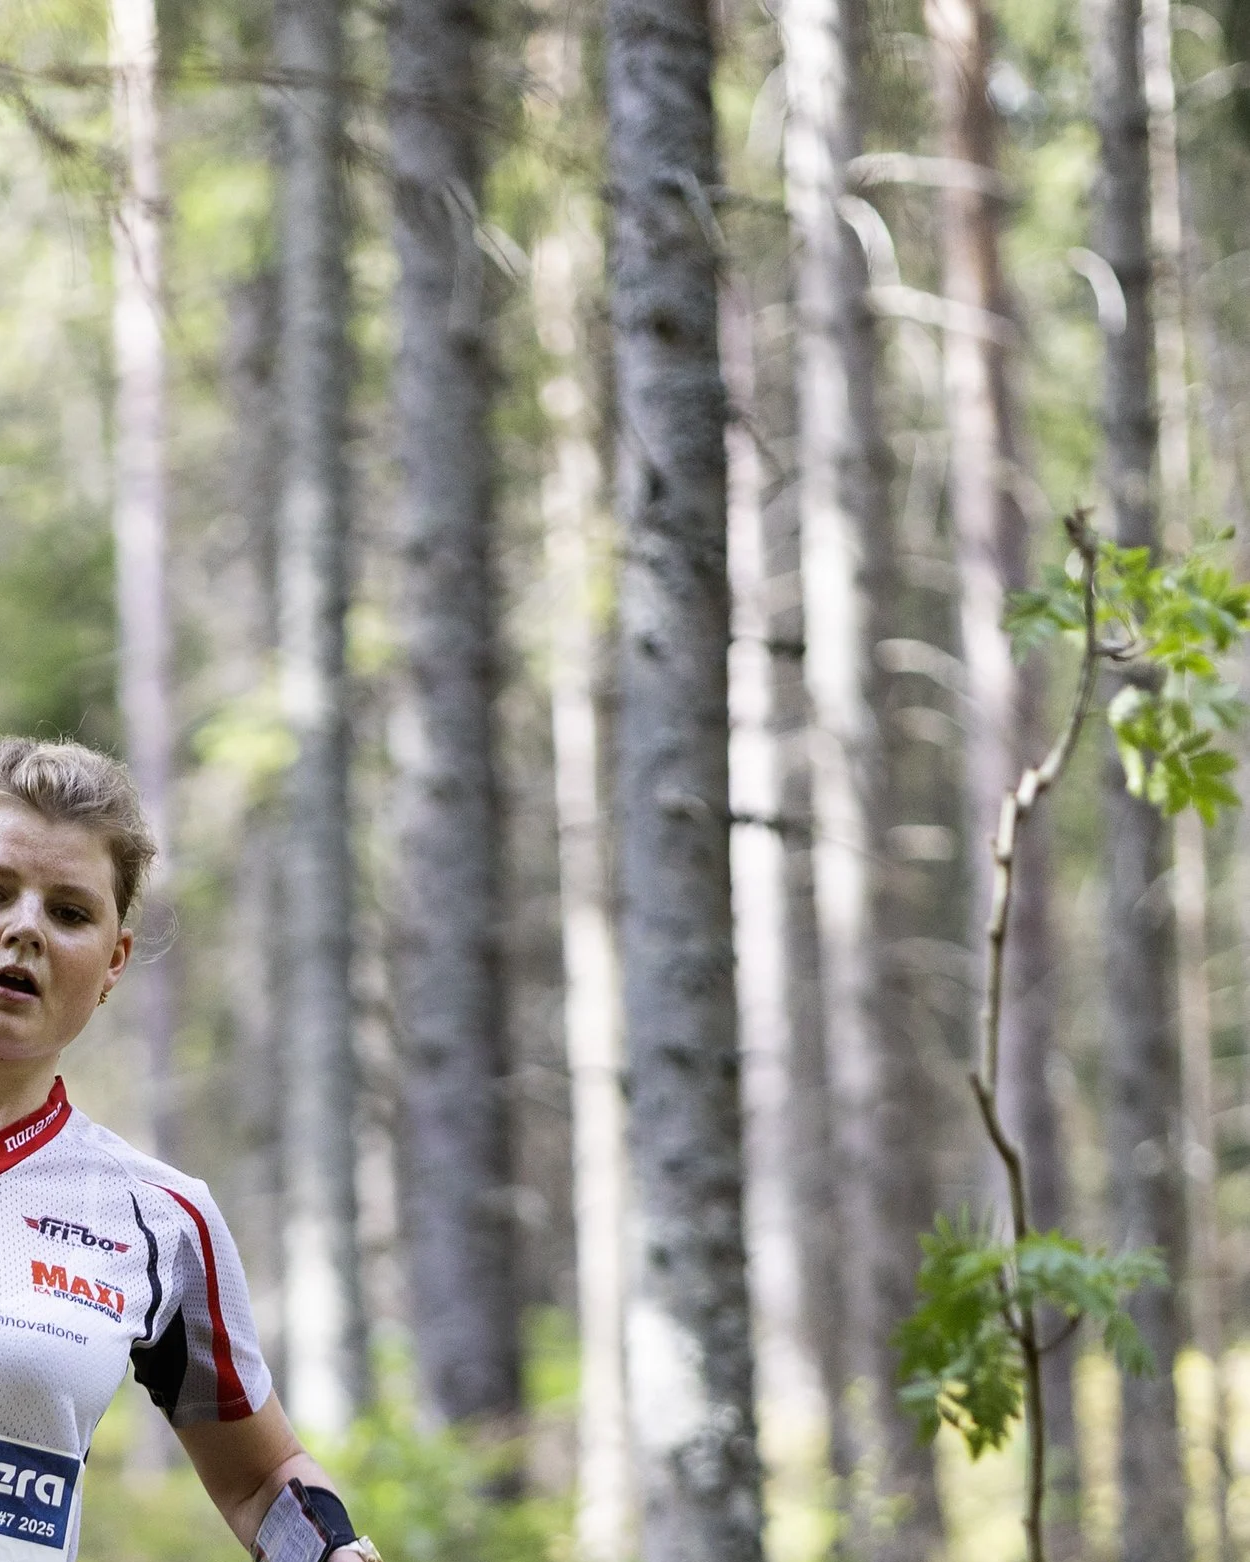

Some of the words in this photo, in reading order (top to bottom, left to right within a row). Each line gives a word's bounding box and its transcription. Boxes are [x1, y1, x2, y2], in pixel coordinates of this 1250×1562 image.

[39, 1217, 114, 1251] fri-bo
[31, 1260, 125, 1315] MAXI
[19, 1516, 55, 1537] 2025
